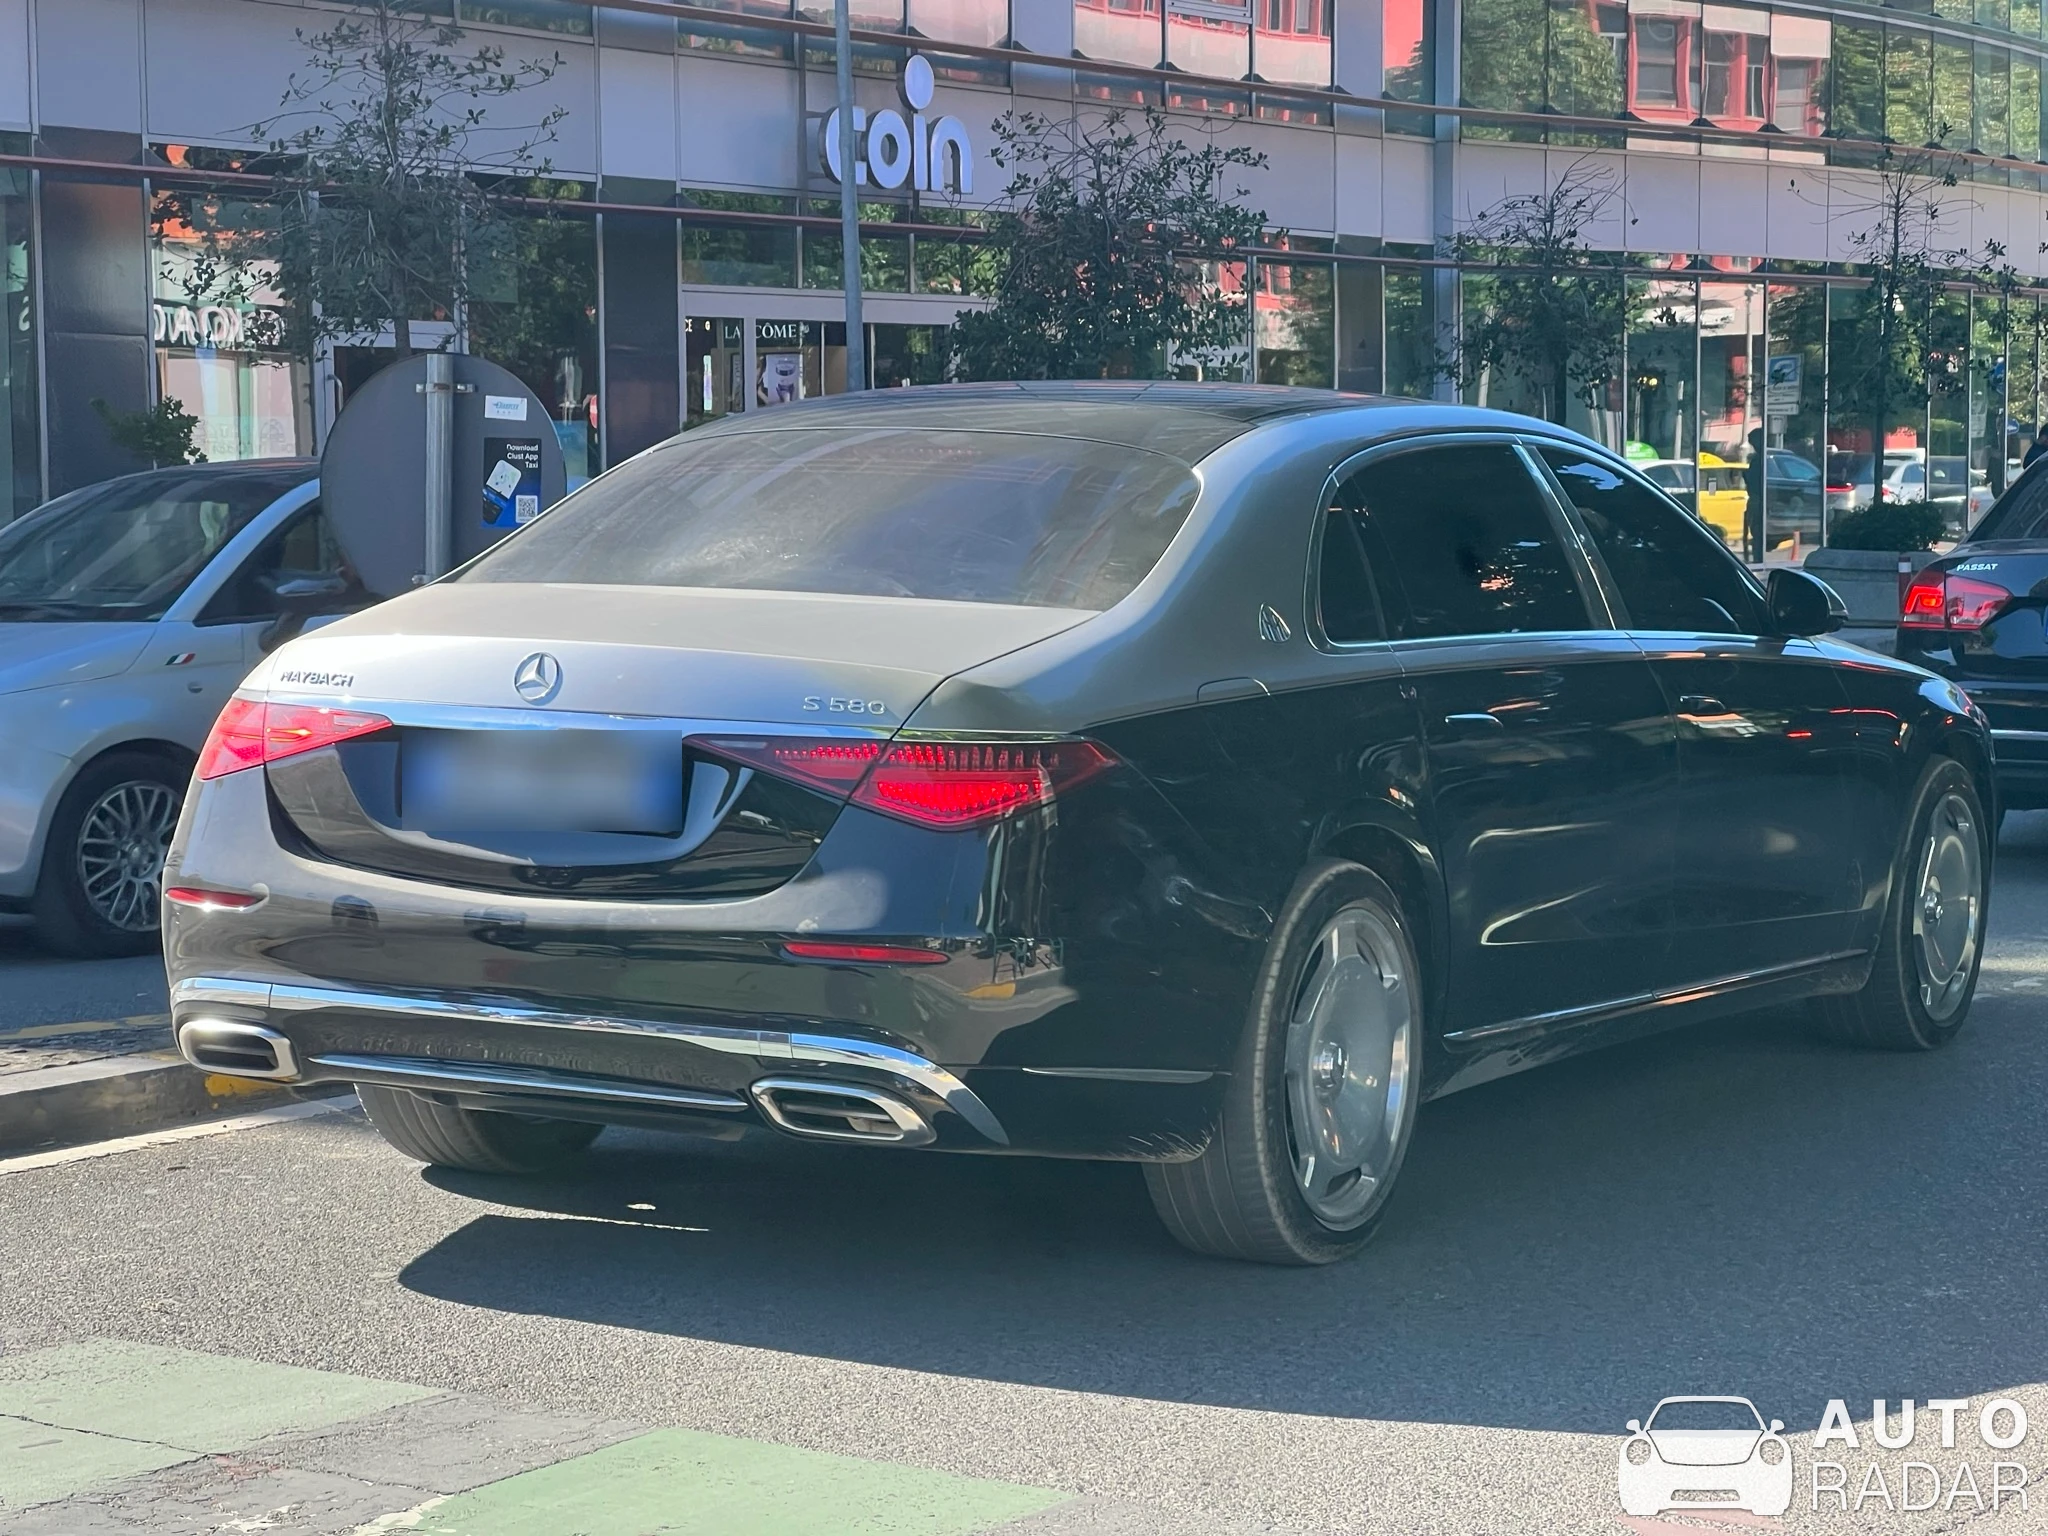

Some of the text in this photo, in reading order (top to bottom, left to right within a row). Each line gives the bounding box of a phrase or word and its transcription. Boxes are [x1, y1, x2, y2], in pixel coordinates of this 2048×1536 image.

[724, 322, 797, 339] LACÔME
[506, 443, 539, 451] Download
[507, 452, 539, 461] Clust App
[1956, 563, 1998, 571] PASSAT
[280, 671, 354, 687] MAYBACH
[803, 696, 885, 715] S 580
